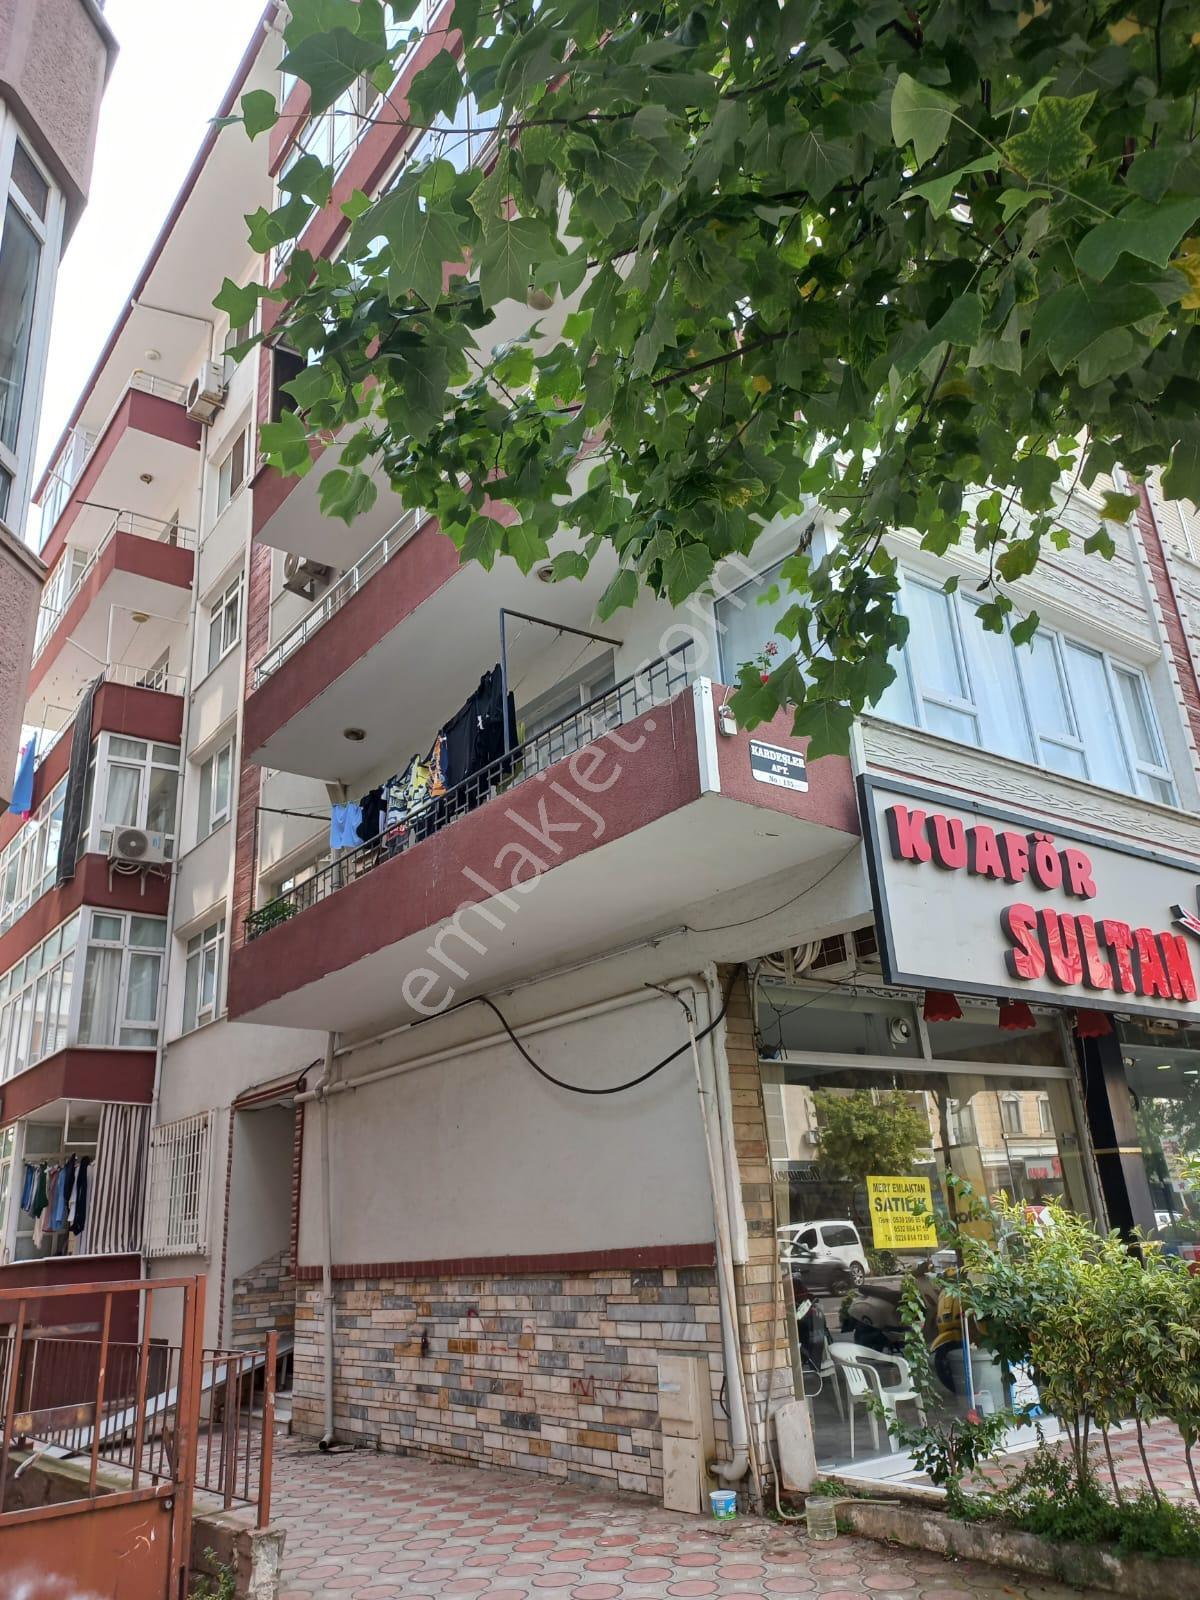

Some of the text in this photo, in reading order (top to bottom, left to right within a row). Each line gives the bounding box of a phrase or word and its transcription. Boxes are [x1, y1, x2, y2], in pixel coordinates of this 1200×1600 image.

[750, 745, 806, 768] KARDEŞLER
[886, 804, 1097, 900] KUAFÖR
[1001, 903, 1198, 1002] SULTAN
[873, 1183, 926, 1193] MERT EMLAKTAN
